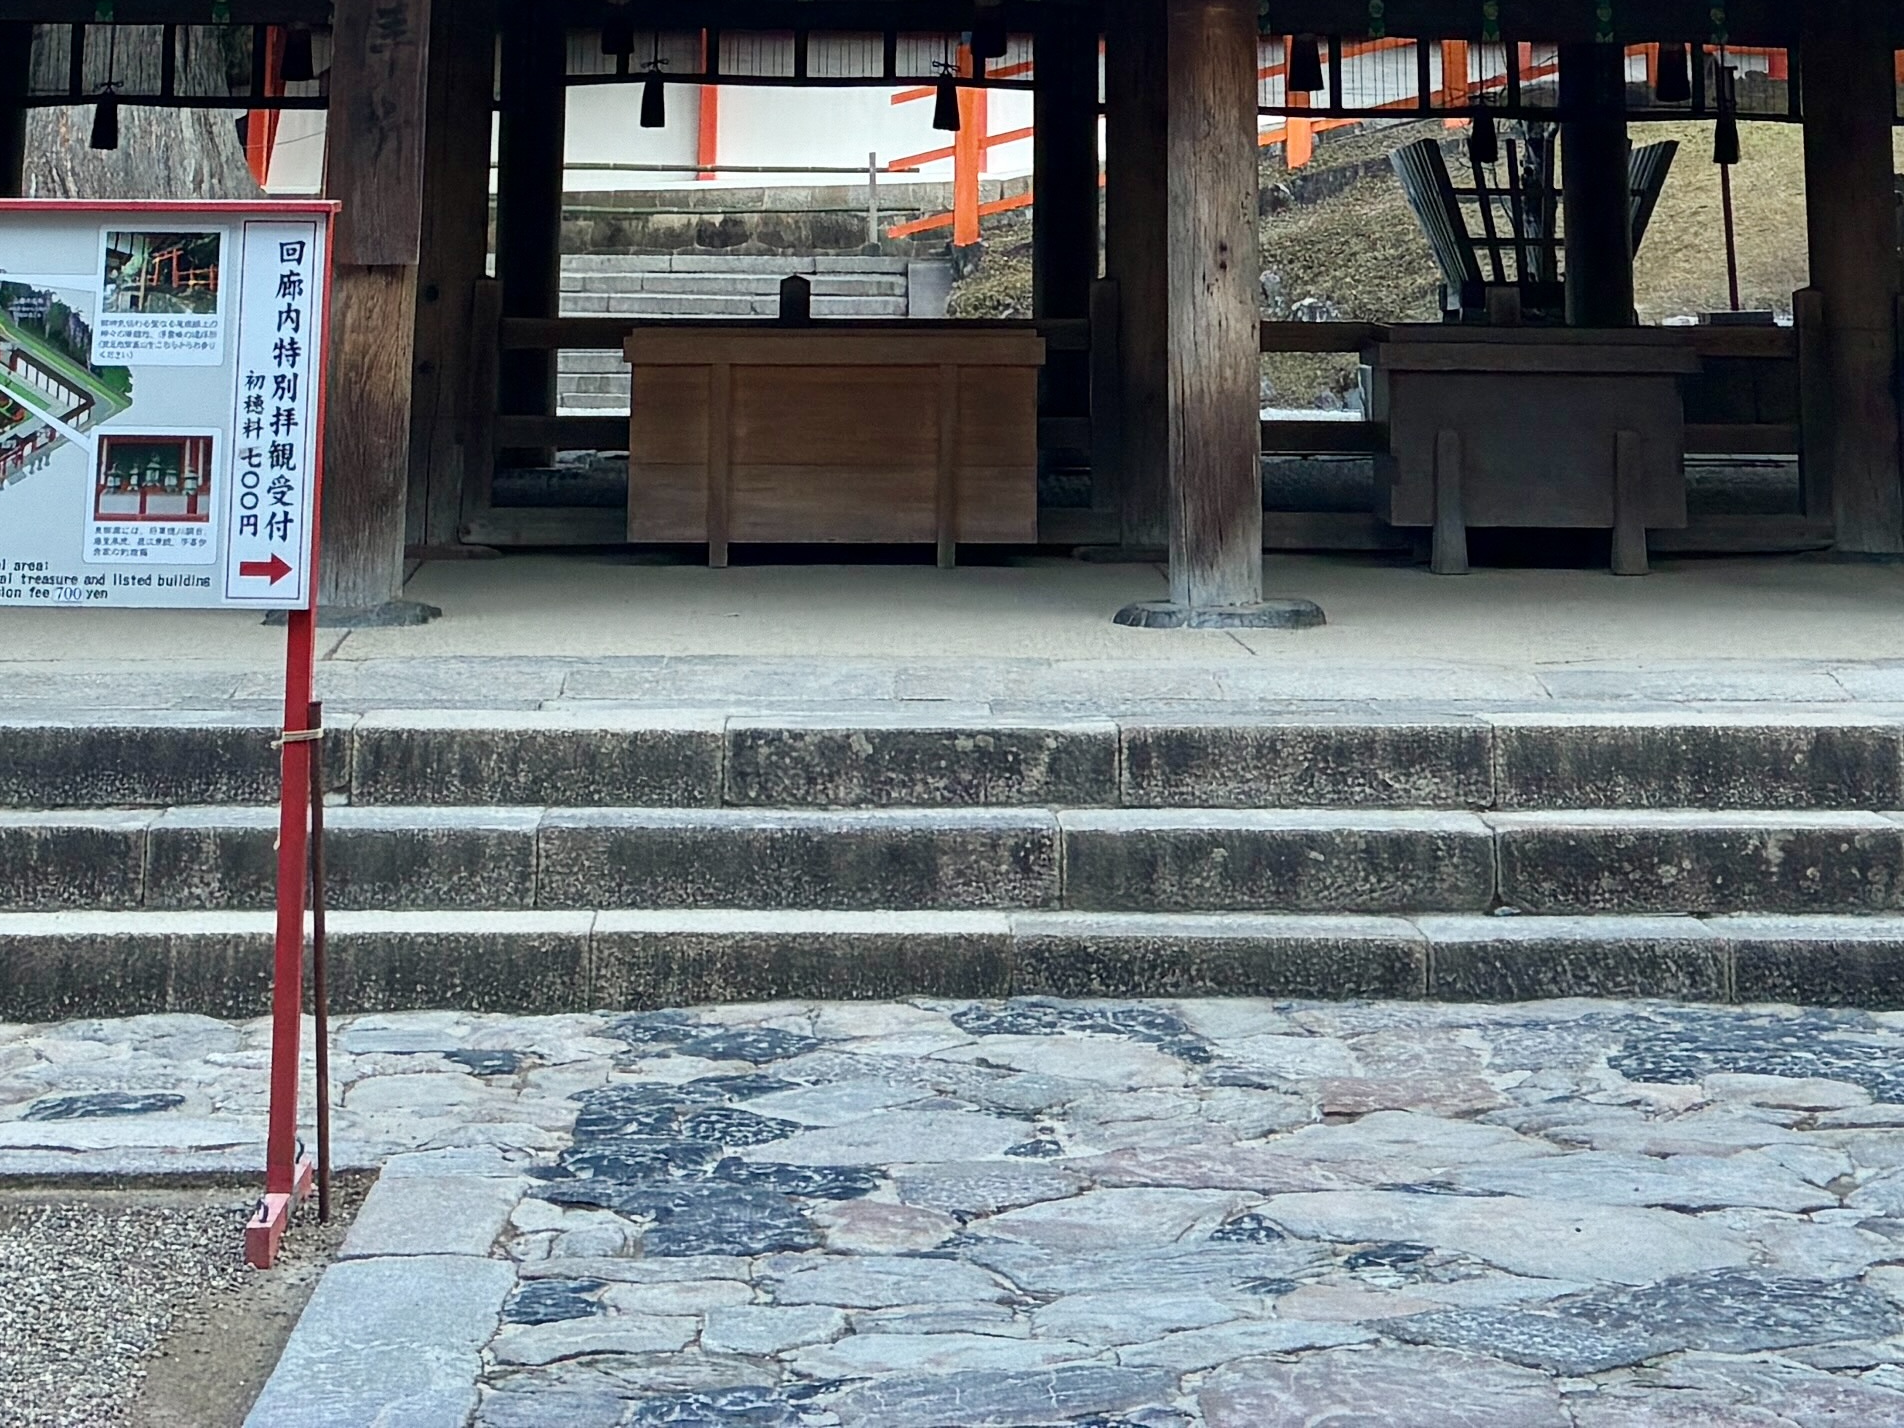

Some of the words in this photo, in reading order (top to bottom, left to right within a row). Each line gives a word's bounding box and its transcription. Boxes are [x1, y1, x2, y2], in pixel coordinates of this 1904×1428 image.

[242, 370, 266, 441] 初穂料
[263, 239, 306, 542] 回廊内特別拝観受付
[21, 574, 78, 586] treasure
[84, 573, 105, 586] and
[113, 573, 152, 586] listed
[29, 586, 50, 598] fee
[56, 587, 82, 601] 700
[86, 589, 108, 600] yen
